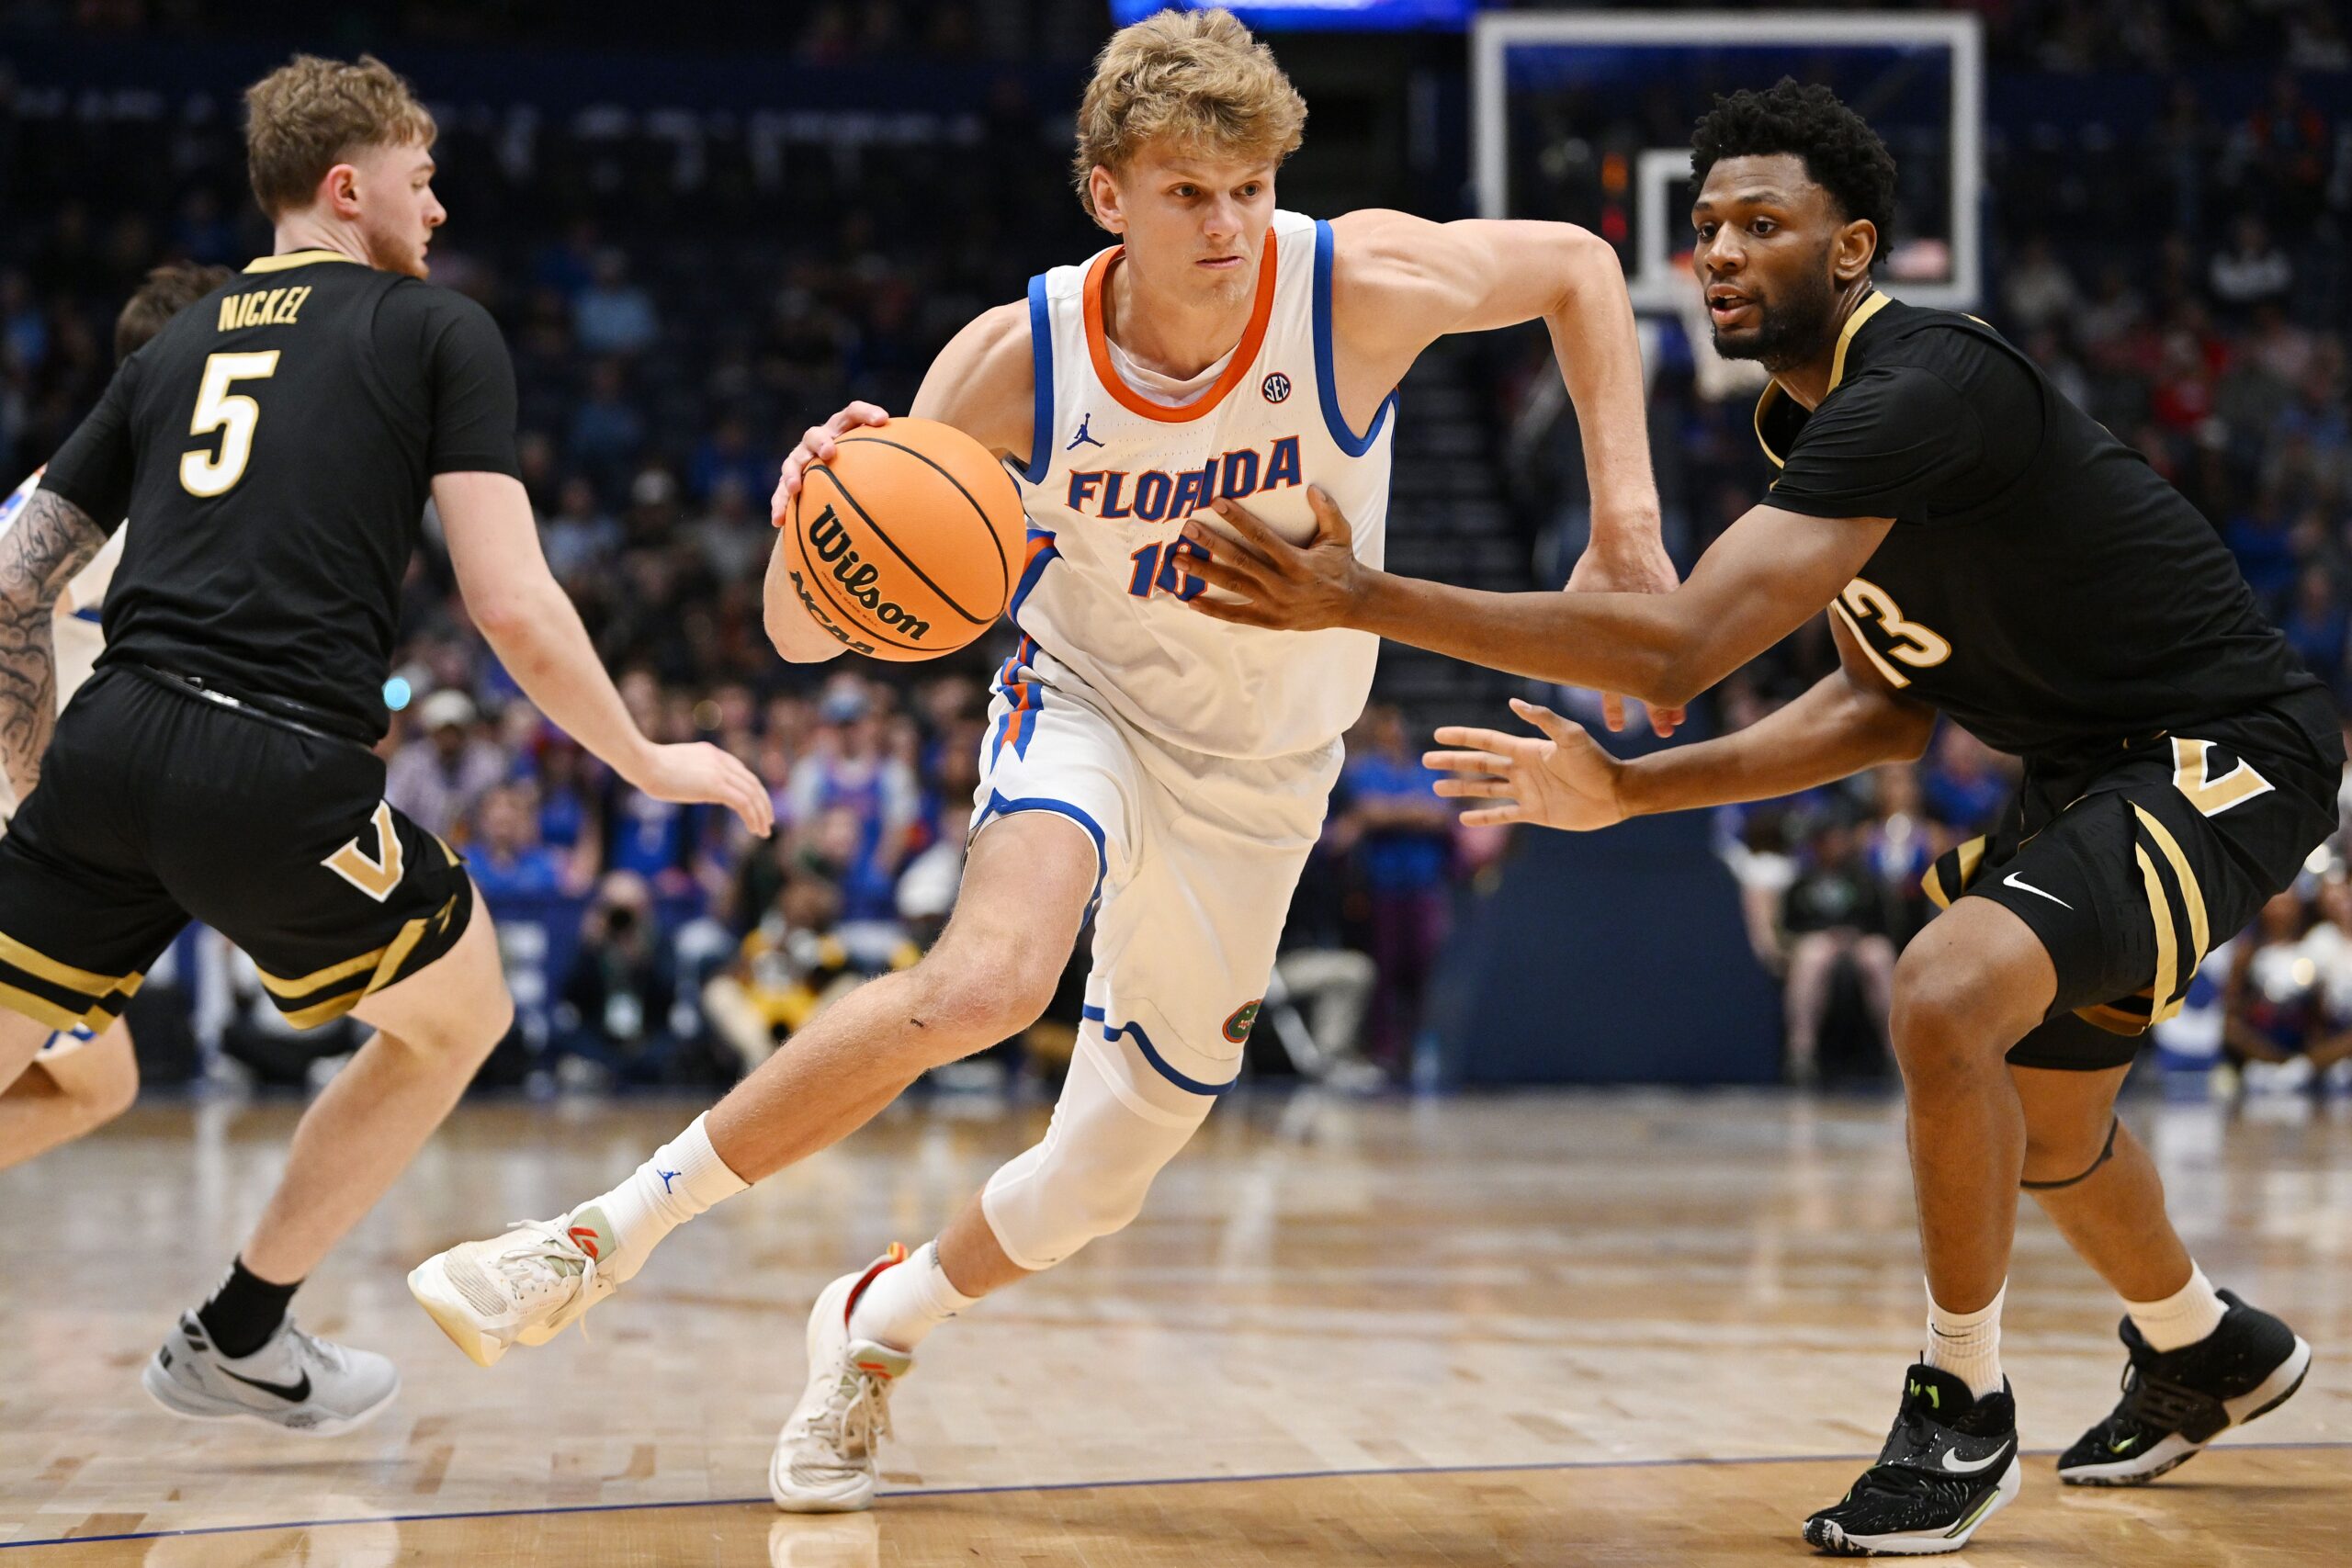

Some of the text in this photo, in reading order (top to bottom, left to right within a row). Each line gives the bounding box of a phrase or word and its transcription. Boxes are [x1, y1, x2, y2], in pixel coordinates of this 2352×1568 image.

[218, 286, 312, 332] NICKEL
[179, 350, 281, 498] 5
[1264, 375, 1289, 402] SEC
[1064, 434, 1303, 525] FLORIDA
[788, 570, 875, 655] NCAA
[808, 502, 931, 641] Wilson
[2169, 736, 2276, 818] V
[320, 798, 404, 903] V
